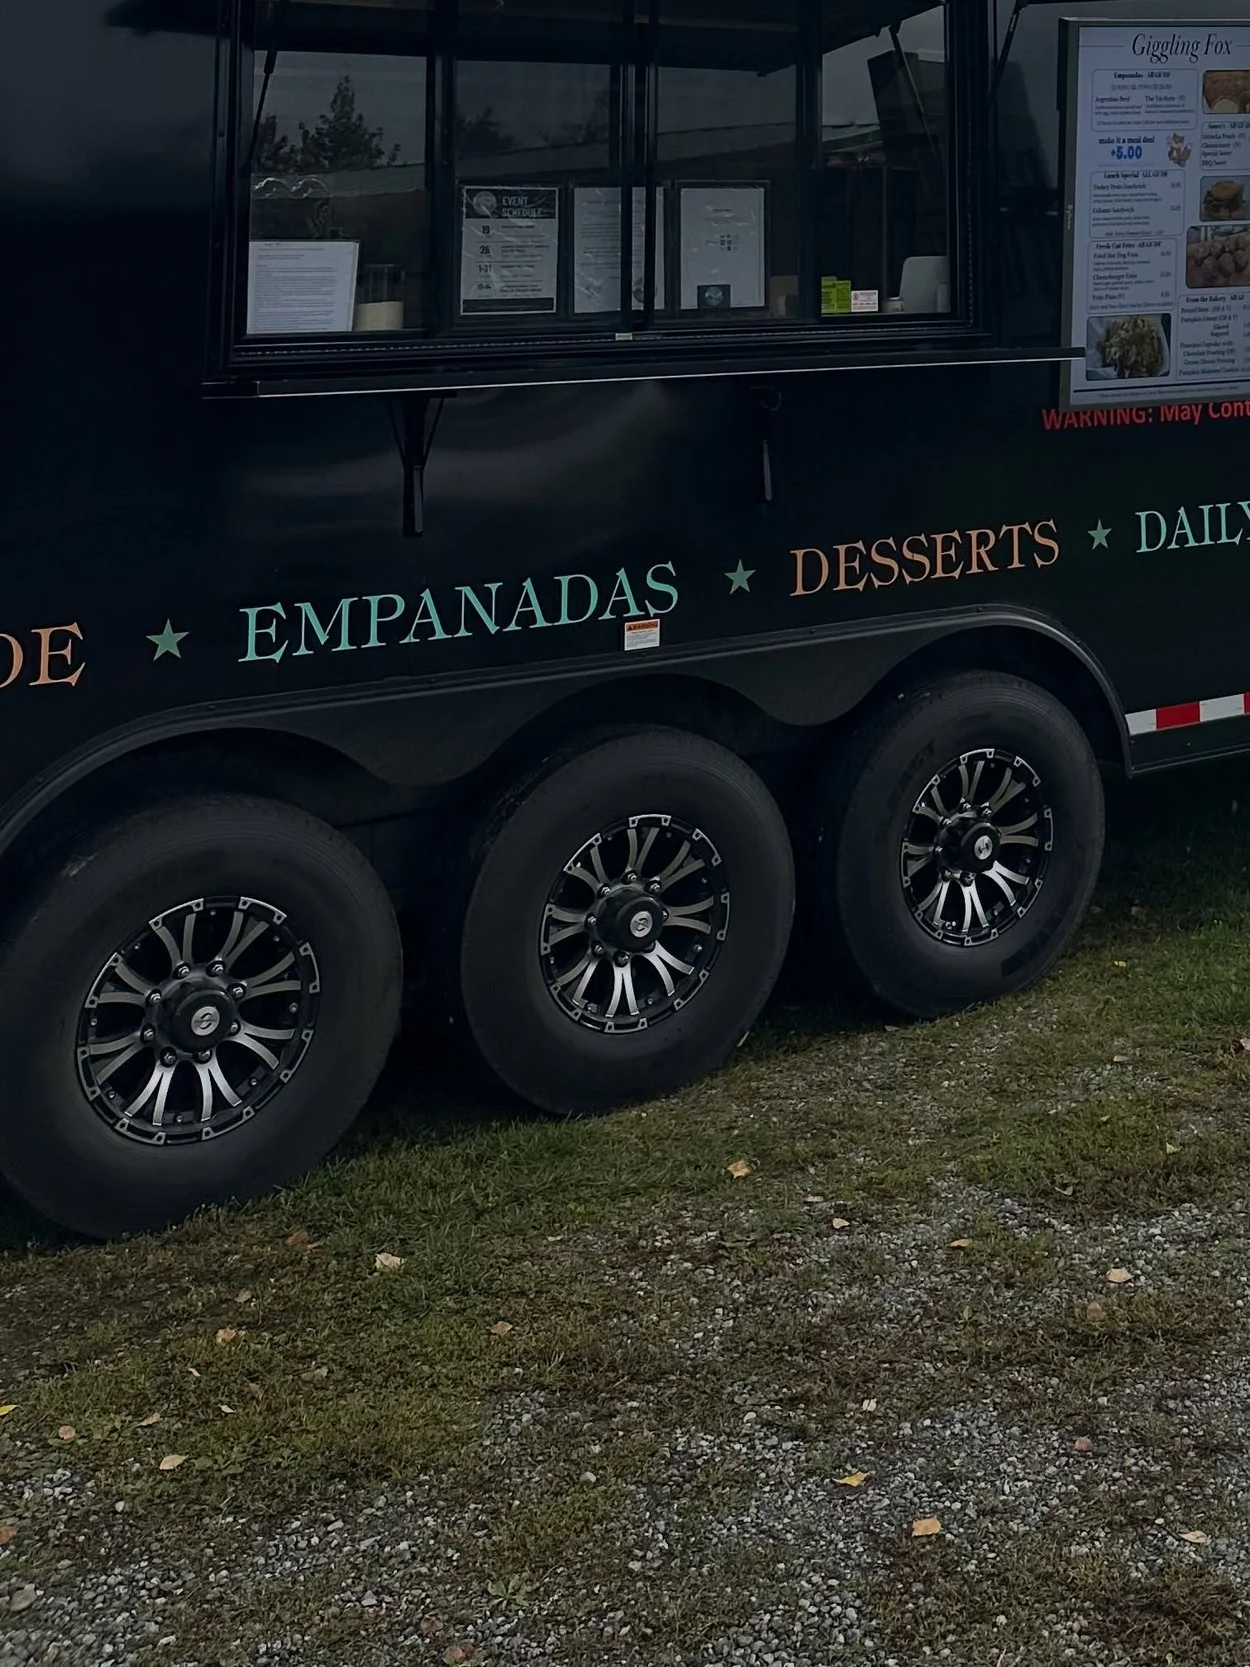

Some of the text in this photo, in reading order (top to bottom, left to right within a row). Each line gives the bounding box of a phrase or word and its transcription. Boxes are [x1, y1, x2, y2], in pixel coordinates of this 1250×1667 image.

[1131, 32, 1233, 64] Giggling Fox
[1111, 145, 1143, 160] +5.00
[502, 196, 529, 207] EVENT
[502, 207, 543, 218] SCHEDULE
[480, 245, 491, 255] 26
[1041, 408, 1152, 431] WARNING:
[1160, 405, 1201, 426] May
[239, 560, 681, 664] EMPANADAS
[790, 518, 1061, 597] DESSERTS
